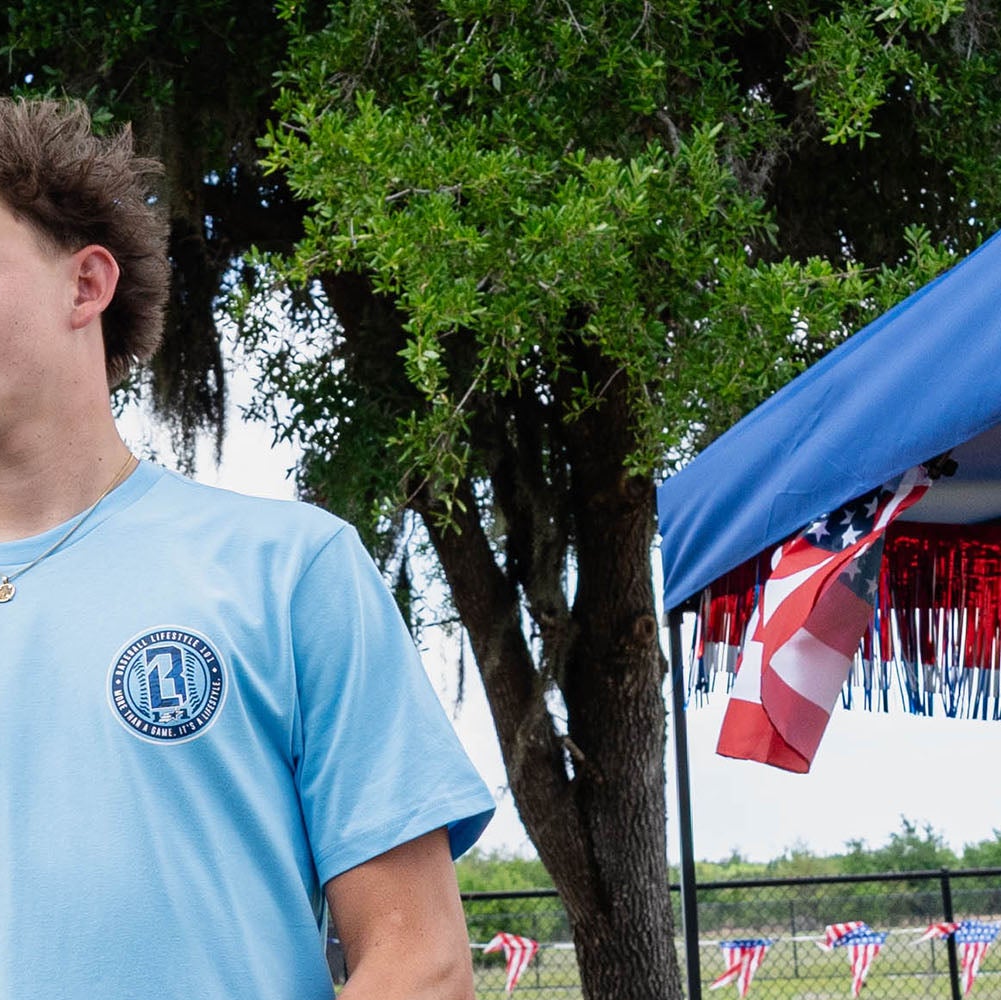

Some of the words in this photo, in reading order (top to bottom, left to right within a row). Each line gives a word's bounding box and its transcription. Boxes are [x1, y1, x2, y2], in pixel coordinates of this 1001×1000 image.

[116, 639, 147, 675] BASEBALL
[150, 632, 199, 647] LIFESTYLE
[199, 647, 214, 663] 101
[114, 690, 127, 710] MORE
[125, 710, 142, 728] THAN
[151, 727, 176, 736] GAME.
[179, 722, 196, 734] IT'S
[196, 717, 203, 725] A
[202, 678, 221, 719] LIFESTYLE.
